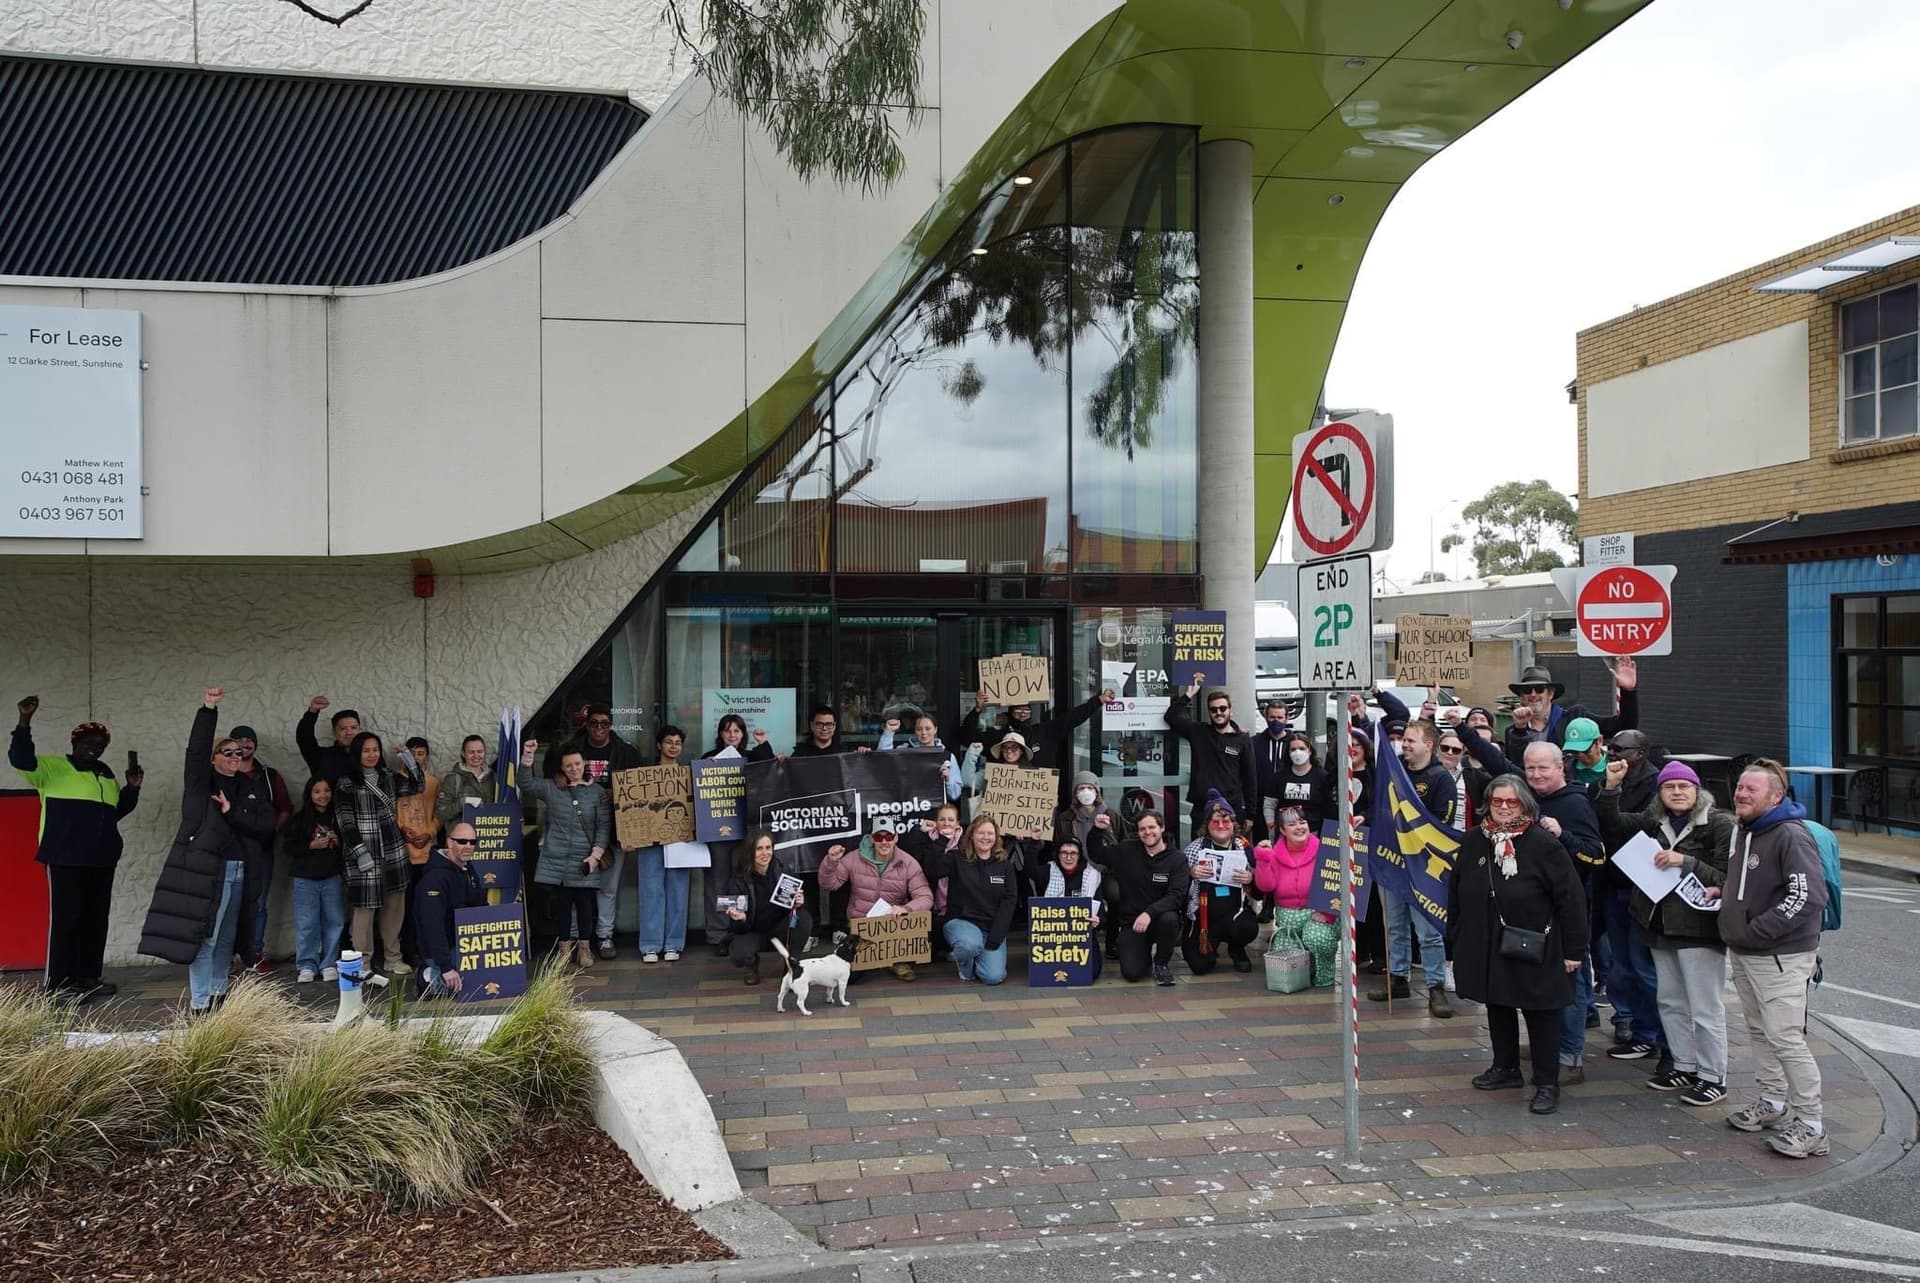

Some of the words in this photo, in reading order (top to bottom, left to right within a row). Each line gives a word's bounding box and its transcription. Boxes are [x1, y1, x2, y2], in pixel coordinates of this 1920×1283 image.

[30, 329, 61, 344] For
[67, 330, 122, 347] Lease
[8, 356, 17, 365] 12
[19, 357, 48, 366] Clarke
[50, 358, 81, 368] Street,
[83, 359, 123, 369] Sunshine
[65, 459, 101, 468] Mathew
[103, 460, 124, 468] Kent
[21, 471, 58, 485] 0431
[63, 472, 93, 485] 068
[97, 473, 124, 485] 481
[63, 495, 101, 505] Anthony
[103, 496, 124, 504] Park
[19, 507, 61, 520] 0403
[65, 508, 93, 521] 967
[98, 508, 124, 521] 501
[1600, 536, 1620, 547] SHOP
[1600, 546, 1626, 556] FITTER
[1317, 569, 1348, 591] END
[1608, 582, 1634, 598] NO
[1124, 624, 1166, 634] Victoria
[1174, 624, 1224, 632] FIREFIGHTER
[1314, 603, 1353, 647] 2P
[1591, 623, 1655, 640] ENTRY
[1124, 634, 1154, 646] Legal
[1174, 634, 1224, 647] SAFETY
[1400, 629, 1420, 644] OUR
[1423, 629, 1472, 645] SCHOOLS
[1174, 649, 1191, 661] AT
[1194, 649, 1224, 661] RISK
[1400, 649, 1469, 664] HOSPITALS
[981, 661, 1002, 677] EPA
[1004, 658, 1046, 673] ACTION
[1313, 660, 1356, 681] AREA
[1398, 666, 1428, 681] AIR
[1440, 667, 1471, 680] WATER
[1136, 670, 1169, 683] EPA
[984, 675, 1043, 699] NOW
[615, 771, 633, 785] WE
[637, 767, 688, 783] DEMAND
[701, 767, 740, 776] VICTORIAN
[993, 767, 1016, 777] PUT
[1025, 771, 1046, 779] THE
[696, 776, 726, 787] LABOR
[991, 777, 1049, 792] BURNING
[618, 778, 688, 802] ACTION
[700, 787, 745, 800] INACTION
[710, 799, 737, 808] BURNS
[867, 797, 932, 818] people
[985, 791, 1014, 805] DUMP
[1016, 796, 1054, 810] SITES
[711, 810, 721, 818] US
[723, 809, 737, 817] ALL
[771, 806, 844, 820] VICTORIAN
[475, 816, 511, 825] BROKEN
[771, 816, 849, 832] SOCIALISTS
[999, 812, 1051, 831] TOORAK
[475, 828, 509, 837] TRUCKS
[479, 840, 504, 849] CAN'T
[492, 851, 517, 860] FIRES
[1031, 906, 1066, 919] Raise
[1069, 906, 1090, 918] the
[458, 920, 521, 935] FIREFIGHTER
[858, 919, 898, 937] FUND
[900, 917, 928, 930] OUR
[1031, 920, 1068, 932] Alarm
[1072, 920, 1090, 931] for
[459, 932, 521, 953] SAFETY
[1031, 933, 1090, 945] Firefighters'
[460, 955, 479, 971] AT
[484, 950, 523, 968] RISK
[1032, 945, 1090, 966] Safety
